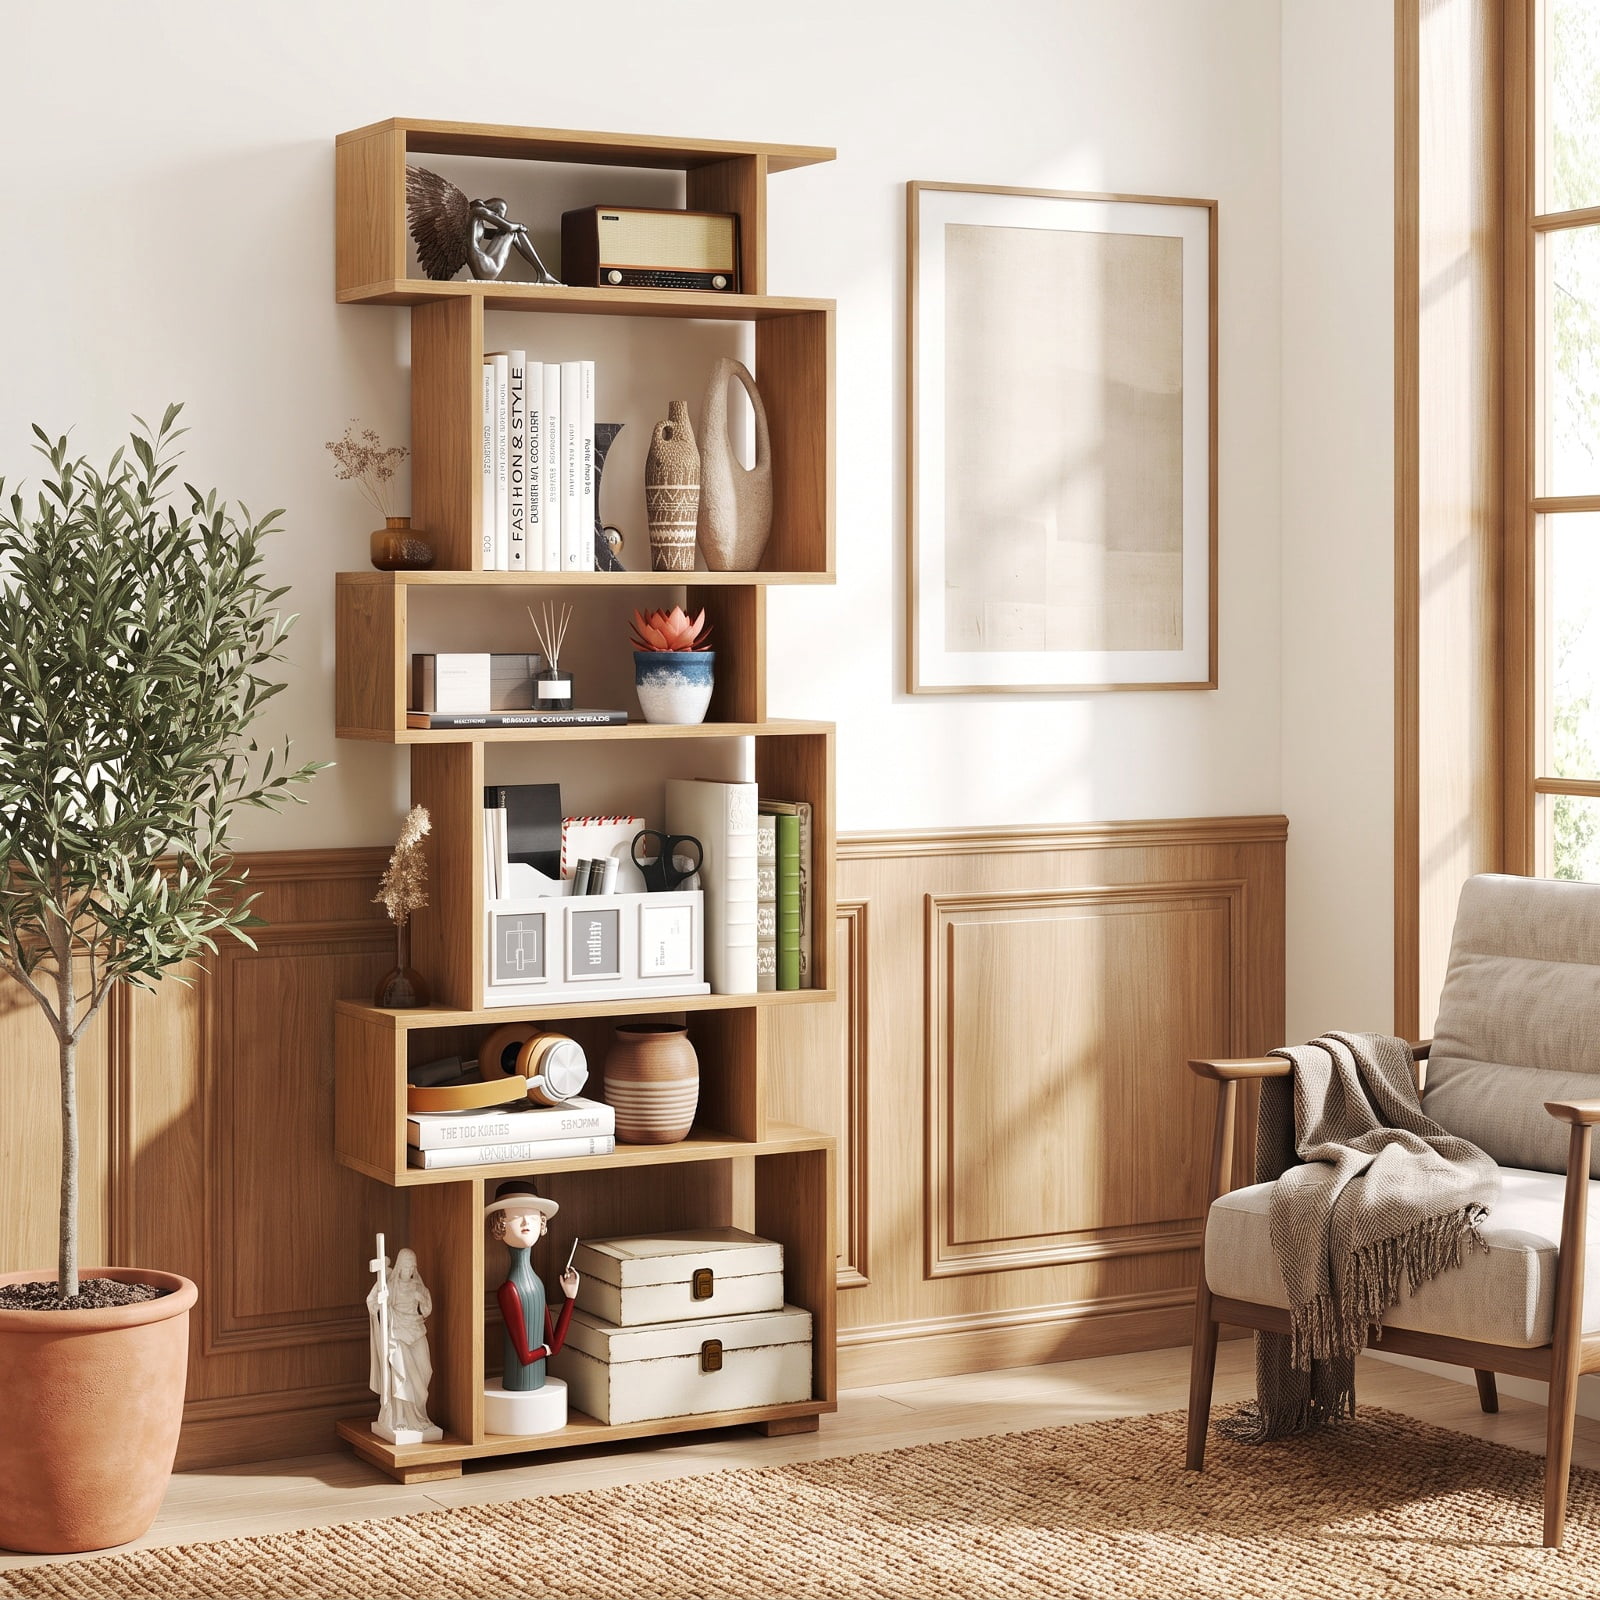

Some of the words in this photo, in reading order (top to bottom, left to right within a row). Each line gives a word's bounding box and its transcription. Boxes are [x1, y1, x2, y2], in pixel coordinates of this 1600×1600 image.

[511, 367, 524, 430] STYLE
[512, 434, 524, 450] &
[440, 1127, 458, 1140] THE
